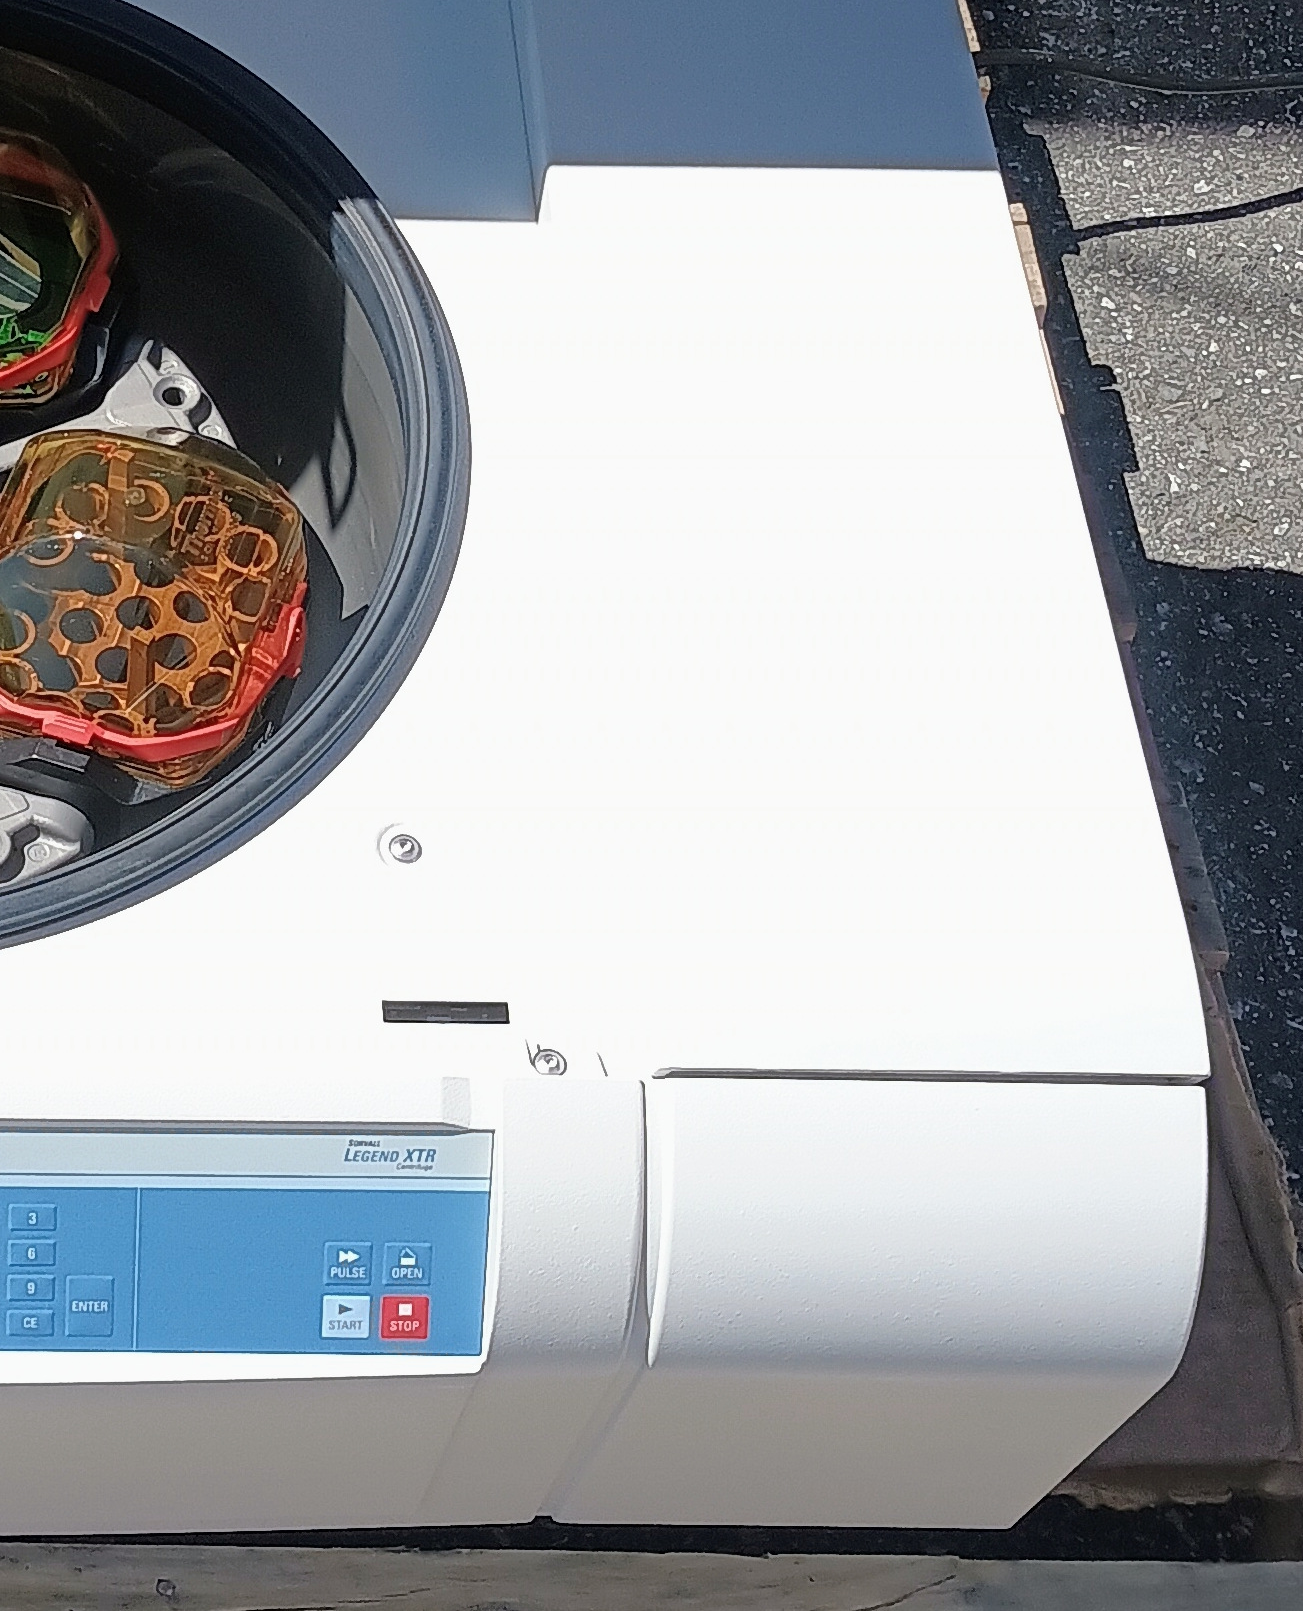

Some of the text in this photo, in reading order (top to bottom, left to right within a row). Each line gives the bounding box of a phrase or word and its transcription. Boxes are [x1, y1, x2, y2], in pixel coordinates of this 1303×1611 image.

[343, 1147, 437, 1163] LEGEND XTR
[28, 1212, 37, 1225] 3
[27, 1247, 36, 1260] 6
[330, 1266, 366, 1279] PULSE
[391, 1267, 423, 1279] OPEN
[27, 1281, 36, 1295] 9
[71, 1300, 108, 1313] ENTER
[23, 1316, 38, 1329] CE
[328, 1319, 363, 1331] START
[389, 1320, 420, 1332] STOP
